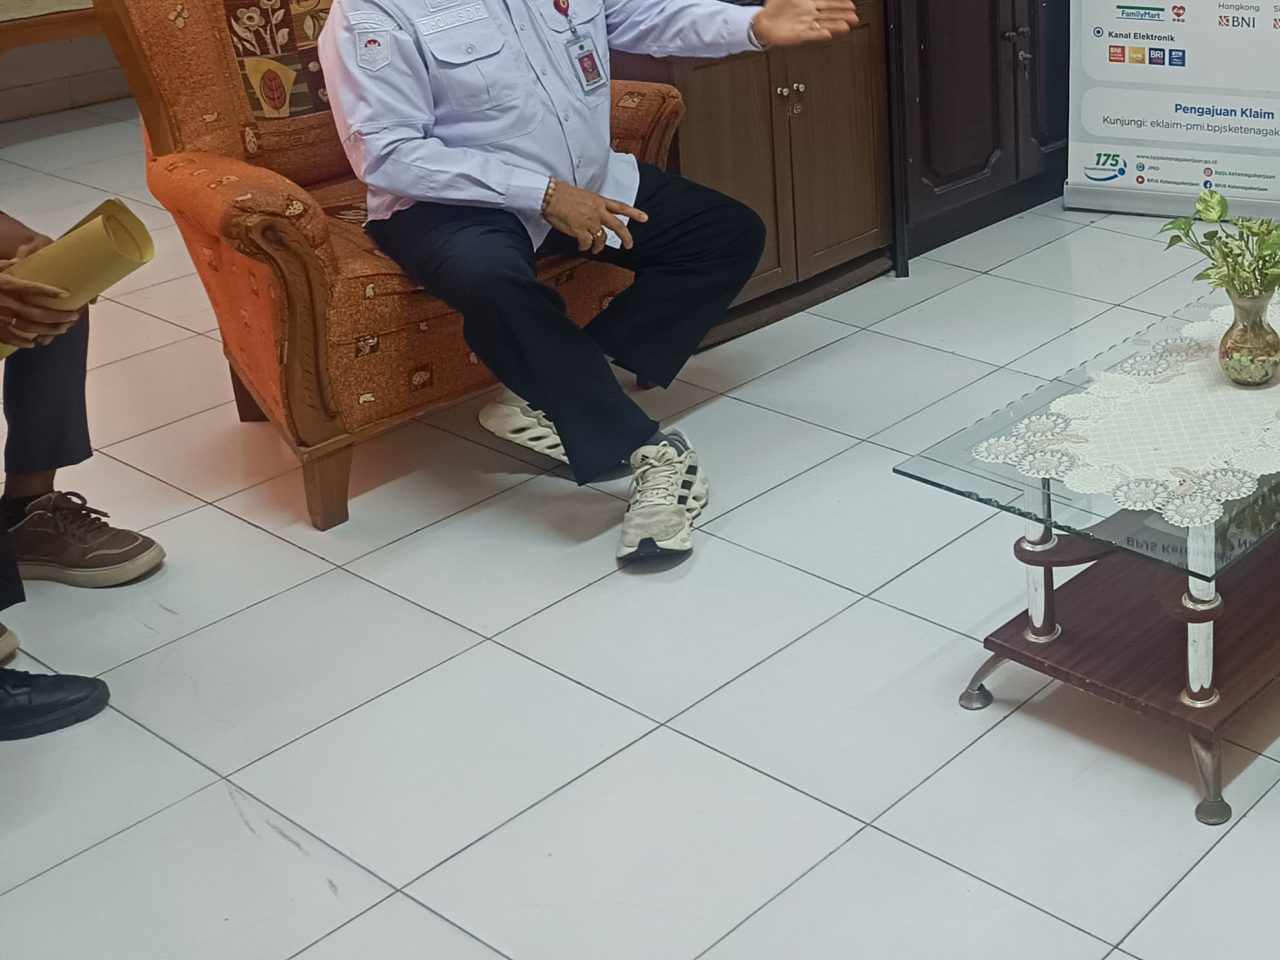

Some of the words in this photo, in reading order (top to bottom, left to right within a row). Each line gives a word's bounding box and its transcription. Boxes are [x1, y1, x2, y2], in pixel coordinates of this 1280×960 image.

[1218, 3, 1260, 12] Hongkong
[1232, 16, 1256, 28] BNI
[1108, 31, 1131, 40] Kanal
[1134, 32, 1175, 42] Elektronik
[1174, 103, 1236, 118] Pengajuan
[1240, 107, 1274, 120] Klaim
[1102, 116, 1148, 128] Kunjungi:
